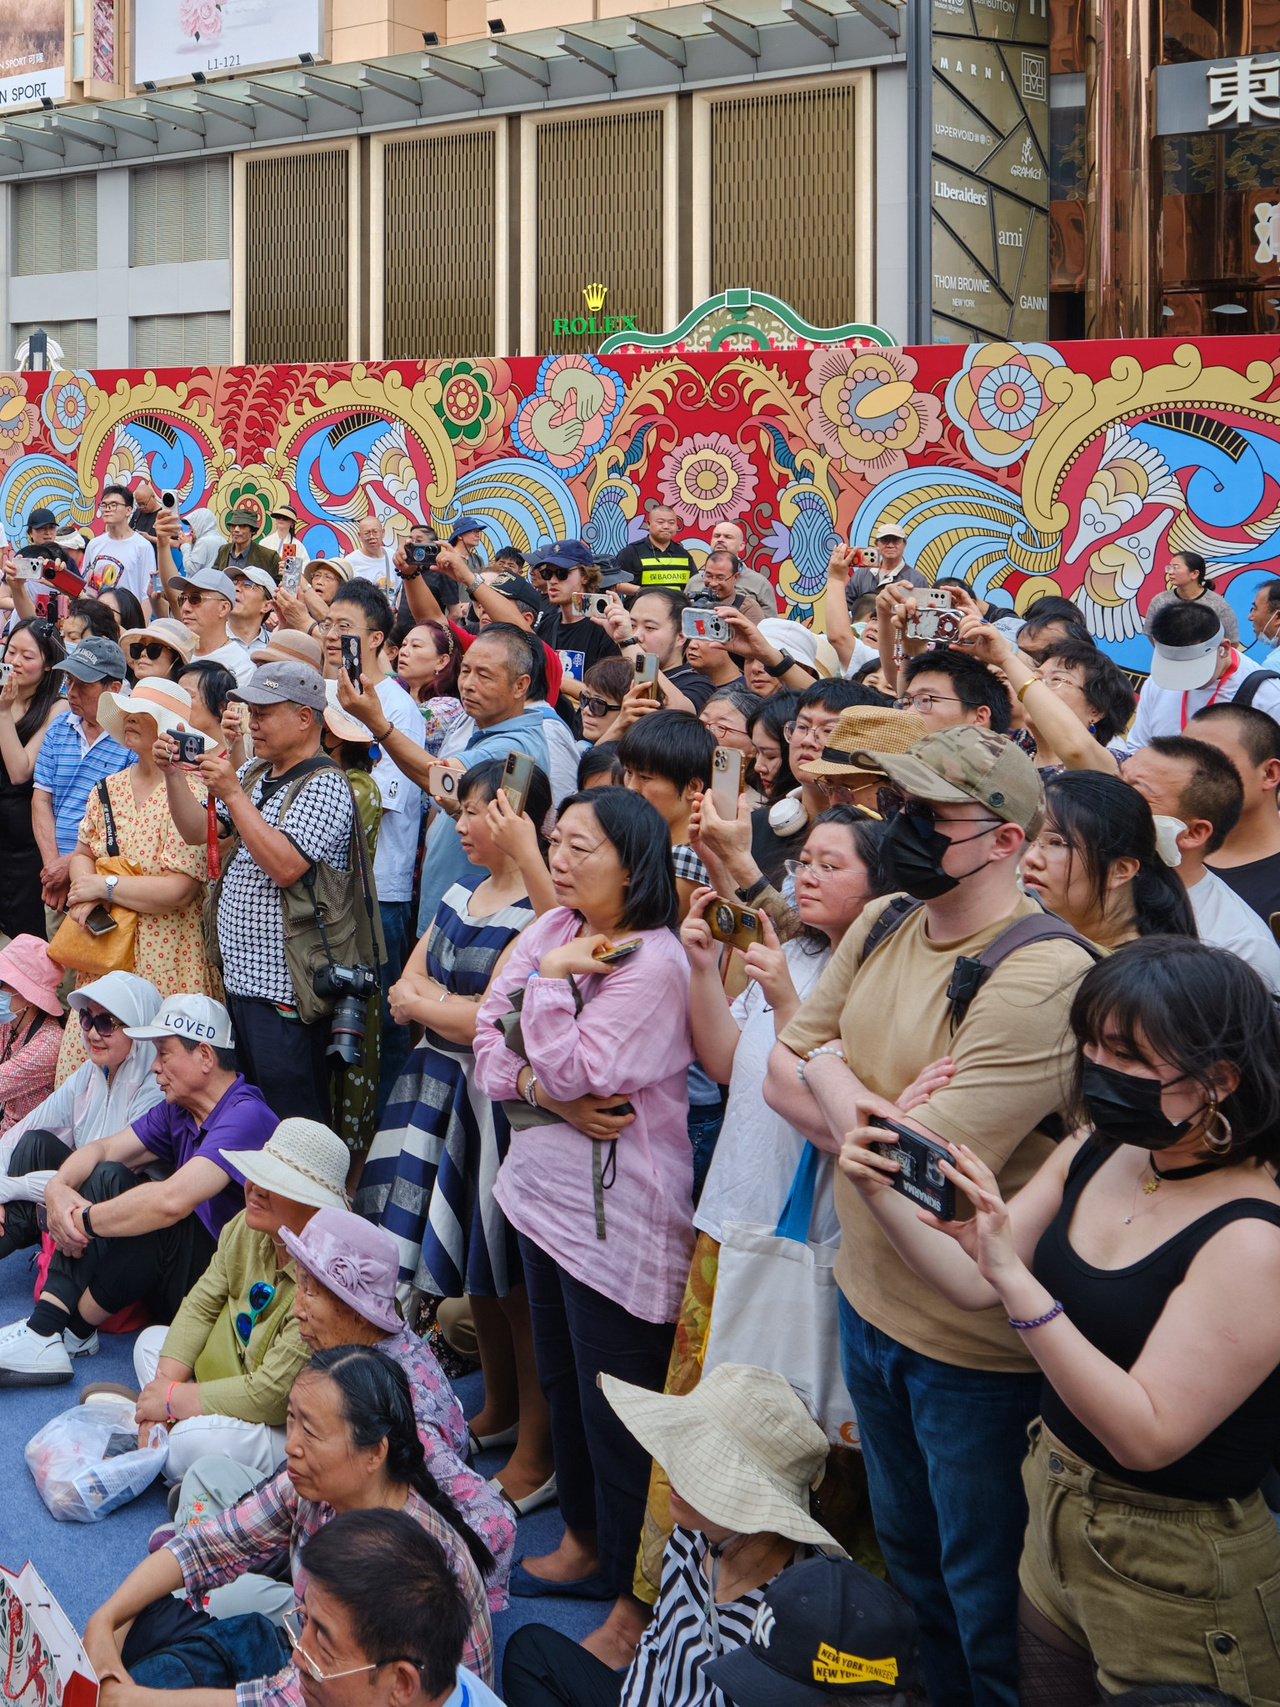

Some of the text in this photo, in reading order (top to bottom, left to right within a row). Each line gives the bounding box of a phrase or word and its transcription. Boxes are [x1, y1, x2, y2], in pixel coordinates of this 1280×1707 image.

[5, 56, 27, 68] SPORT
[207, 54, 241, 70] L1-121
[940, 57, 1005, 82] MARNI
[11, 82, 47, 102] SPORT
[934, 181, 988, 207] Liberaiders
[998, 227, 1024, 248] ami
[934, 274, 957, 290] THOM
[952, 298, 976, 308] NEW YORK
[553, 315, 638, 336] ROLEX
[165, 1014, 216, 1040] LOVED
[816, 1666, 837, 1678] NEW
[821, 1648, 840, 1665] NEW
[842, 1656, 863, 1672] YORK
[865, 1664, 895, 1681] YANKEES
